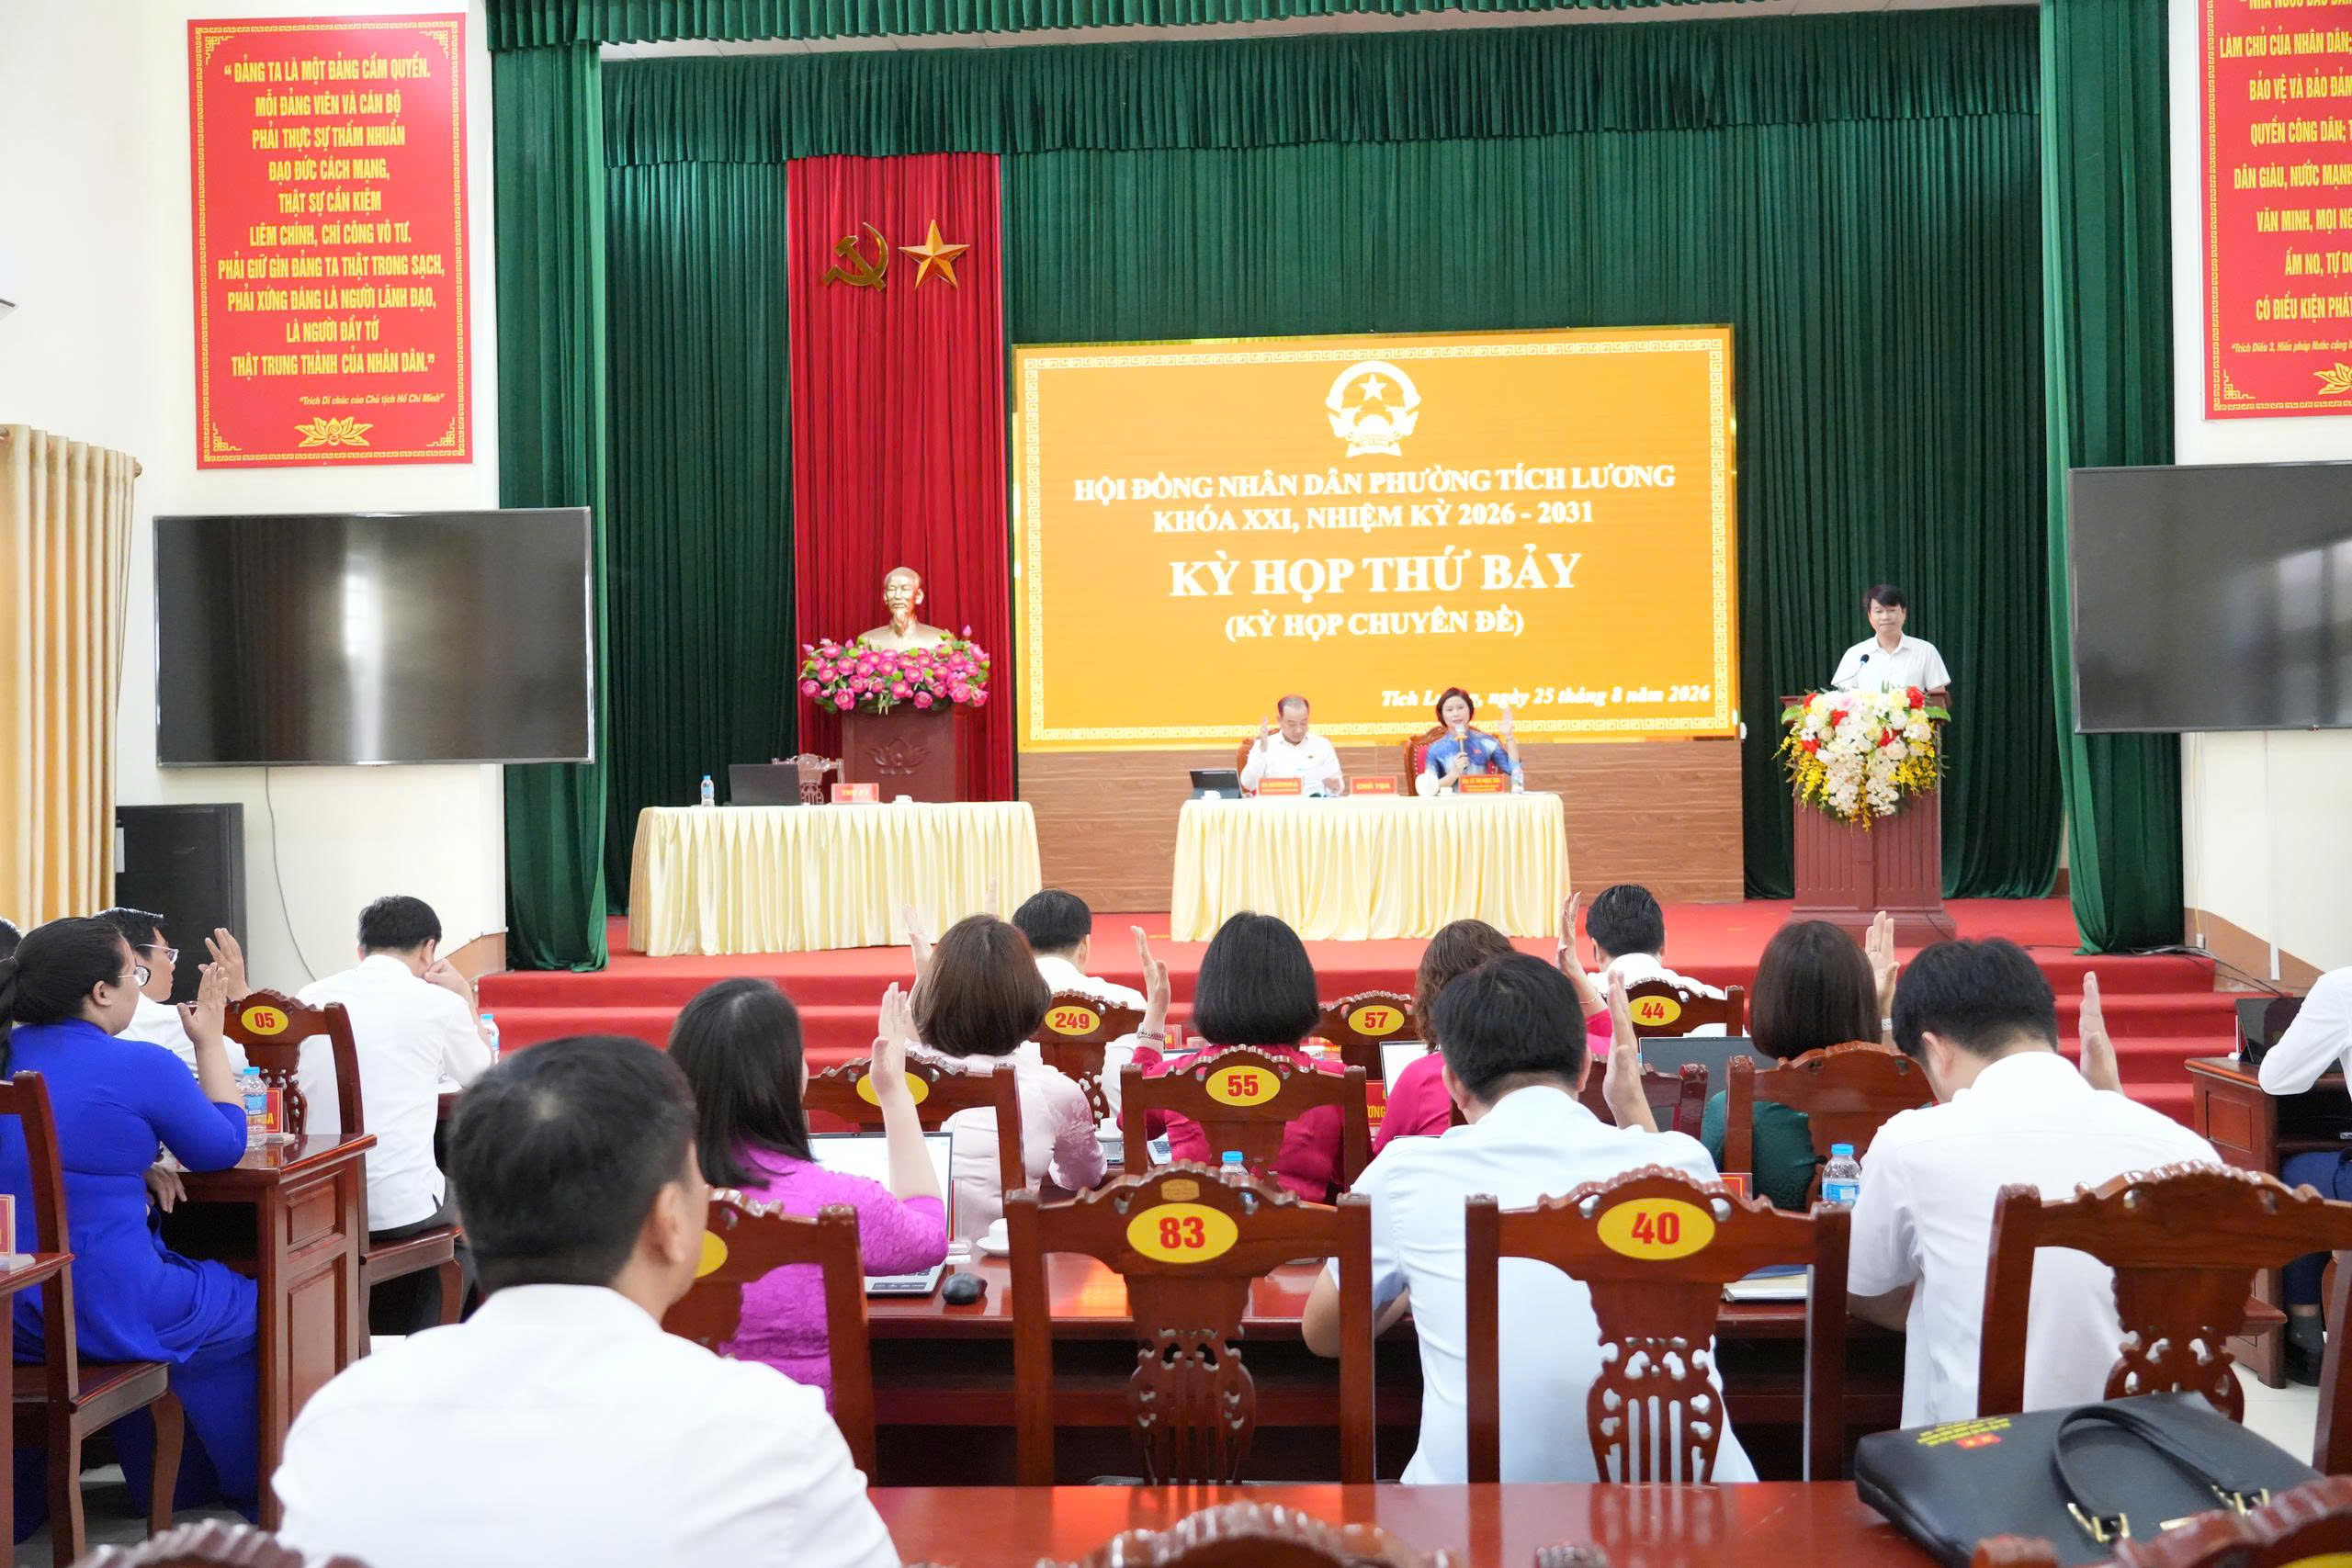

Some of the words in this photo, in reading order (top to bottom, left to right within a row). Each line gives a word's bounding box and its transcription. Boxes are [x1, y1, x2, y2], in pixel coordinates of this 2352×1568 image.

[2220, 32, 2243, 59] LÀM
[2245, 26, 2267, 56] CHỦ
[2270, 25, 2291, 56] CỦA
[2294, 28, 2324, 54] NHÂN
[268, 62, 282, 82] TA
[285, 57, 299, 81] LÀ
[301, 56, 325, 85] MỘT
[329, 51, 359, 80] ĐẢNG
[2250, 70, 2271, 101] BẢO
[2273, 73, 2287, 104] VỆ
[2290, 73, 2303, 99] VÀ
[2306, 68, 2327, 98] BẢO
[279, 87, 311, 116] ĐẢNG
[314, 91, 340, 115] VIÊN
[342, 90, 356, 114] VÀ
[360, 89, 383, 114] CÁN
[386, 89, 401, 118] BỘ
[252, 120, 278, 149] PHẢI
[282, 125, 311, 152] THỰC
[314, 124, 331, 152] SỰ
[2251, 114, 2286, 147] QUYỀN
[2289, 118, 2317, 142] CÔNG
[2321, 116, 2346, 143] DÂN;
[268, 160, 291, 186] ĐẠO
[294, 154, 317, 181] ĐỨC
[320, 154, 350, 180] CÁCH
[353, 158, 390, 184] MẠNG,
[2234, 164, 2256, 189] DÂN
[2259, 162, 2288, 190] GIÀU,
[2290, 159, 2320, 187] NƯỚC
[278, 188, 306, 218] THẬT
[309, 190, 325, 217] SỰ
[353, 186, 381, 216] KIỆM
[250, 221, 277, 246] LIÊM
[280, 220, 318, 247] CHÍNH,
[322, 220, 340, 244] CHÍ
[343, 220, 374, 244] CÔNG
[376, 219, 391, 243] VÔ
[393, 220, 412, 243] TƯ.
[2256, 206, 2278, 232] VĂN
[2281, 209, 2313, 232] MINH,
[2316, 208, 2336, 234] MỌI
[218, 251, 244, 279] PHẢI
[247, 254, 267, 278] GIỮ
[269, 254, 288, 278] GÌN
[291, 250, 322, 277] ĐẢNG
[325, 257, 339, 276] TA
[342, 252, 368, 280] THẬT
[372, 255, 408, 276] TRONG
[412, 254, 445, 279] SẠCH,
[2286, 246, 2302, 276] ẤM
[2305, 254, 2324, 276] NO,
[2326, 250, 2341, 278] TỰ
[228, 283, 254, 311] PHẢI
[256, 285, 288, 310] XỨNG
[290, 286, 321, 310] ĐÁNG
[324, 285, 338, 309] LÀ
[341, 283, 375, 309] NGƯỜI
[379, 285, 407, 308] LÃNH
[410, 287, 436, 311] ĐẠO,
[2256, 295, 2271, 321] CÓ
[2274, 290, 2297, 320] ĐIỀU
[2301, 293, 2325, 323] KIỆN
[287, 319, 300, 343] LÀ
[303, 316, 337, 342] NGƯỜI
[365, 314, 379, 341] TỚ
[232, 352, 258, 380] THẬT
[261, 355, 298, 375] TRUNG
[301, 350, 338, 374] THÀNH
[342, 345, 364, 373] CỦA
[367, 348, 399, 373] NHÂN
[1073, 476, 1126, 506] HỘI
[1132, 471, 1213, 500] ĐỒNG
[1219, 468, 1297, 497] NHÂN
[1304, 467, 1363, 496] DÂN
[1369, 464, 1491, 494] PHƯỜNG
[1496, 462, 1566, 491] TÍCH
[1572, 462, 1676, 490] LƯƠNG
[1153, 502, 1236, 534] KHÓA
[1242, 508, 1300, 534] XXI,
[1306, 502, 1403, 534] NHIỆM
[1410, 498, 1453, 526] KỲ
[1458, 502, 1516, 525] 2026
[1537, 500, 1593, 524] 2031
[1169, 549, 1241, 597] KỲ
[1251, 558, 1354, 604] HỌP
[1363, 545, 1473, 592] THỨ
[1481, 543, 1582, 590] BẢY
[1226, 609, 1276, 642] (KỲ
[1283, 614, 1343, 641] HỌP
[1348, 605, 1468, 635] CHUYÊN
[1487, 689, 1530, 708] ngày
[1533, 687, 1555, 705] 25
[1557, 686, 1607, 707] tháng
[1611, 686, 1622, 703] 8
[1626, 686, 1664, 703] năm
[1668, 685, 1711, 703] 2026
[254, 1012, 275, 1029] 05
[1055, 1011, 1090, 1029] 249
[1364, 1012, 1388, 1029] 57
[1641, 1003, 1664, 1019] 44
[1227, 1075, 1259, 1097] 55
[1159, 1216, 1205, 1249] 83
[1630, 1211, 1679, 1245] 40
